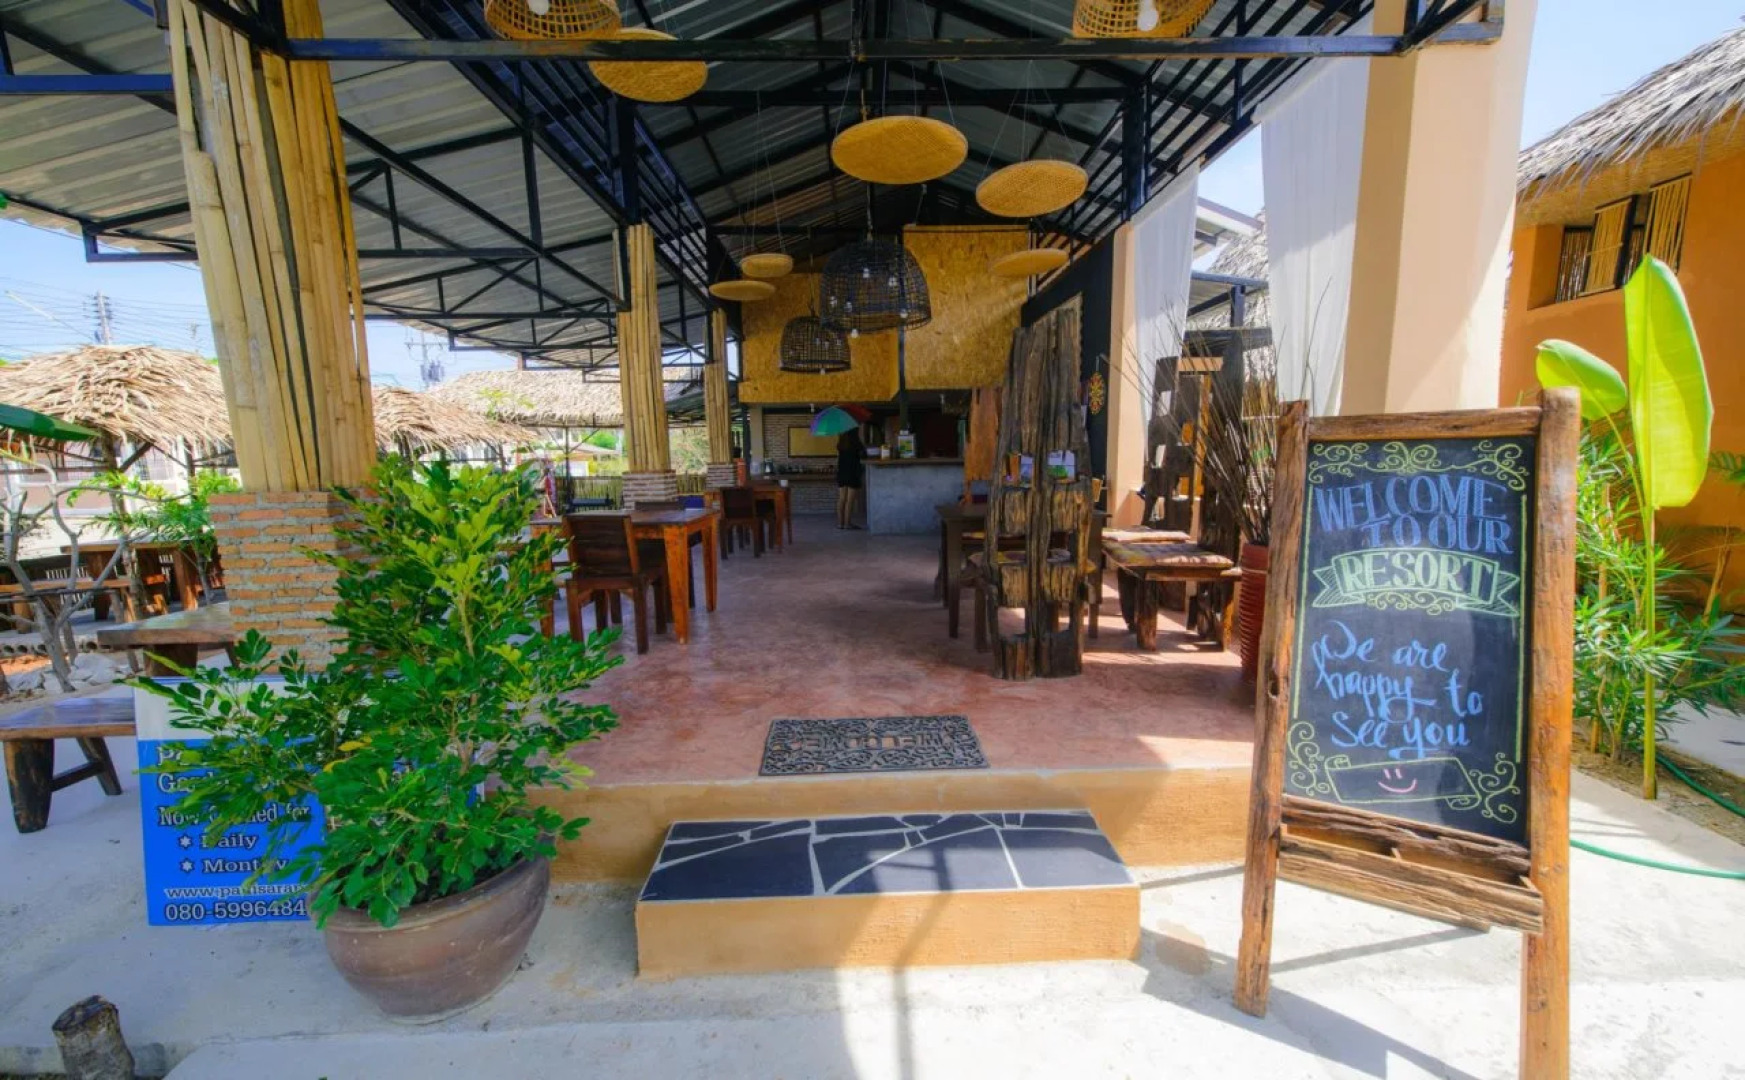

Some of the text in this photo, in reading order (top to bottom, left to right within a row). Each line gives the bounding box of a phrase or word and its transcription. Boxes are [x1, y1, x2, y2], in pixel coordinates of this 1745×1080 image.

[1314, 474, 1507, 533] WELCOME
[1361, 513, 1514, 554] TO OUR
[1340, 551, 1494, 602] RESORT
[1319, 620, 1450, 673] We are
[1312, 643, 1484, 723] happy to
[1388, 721, 1472, 760] you
[203, 858, 289, 874] Monty
[164, 899, 308, 921] 080-5996484
